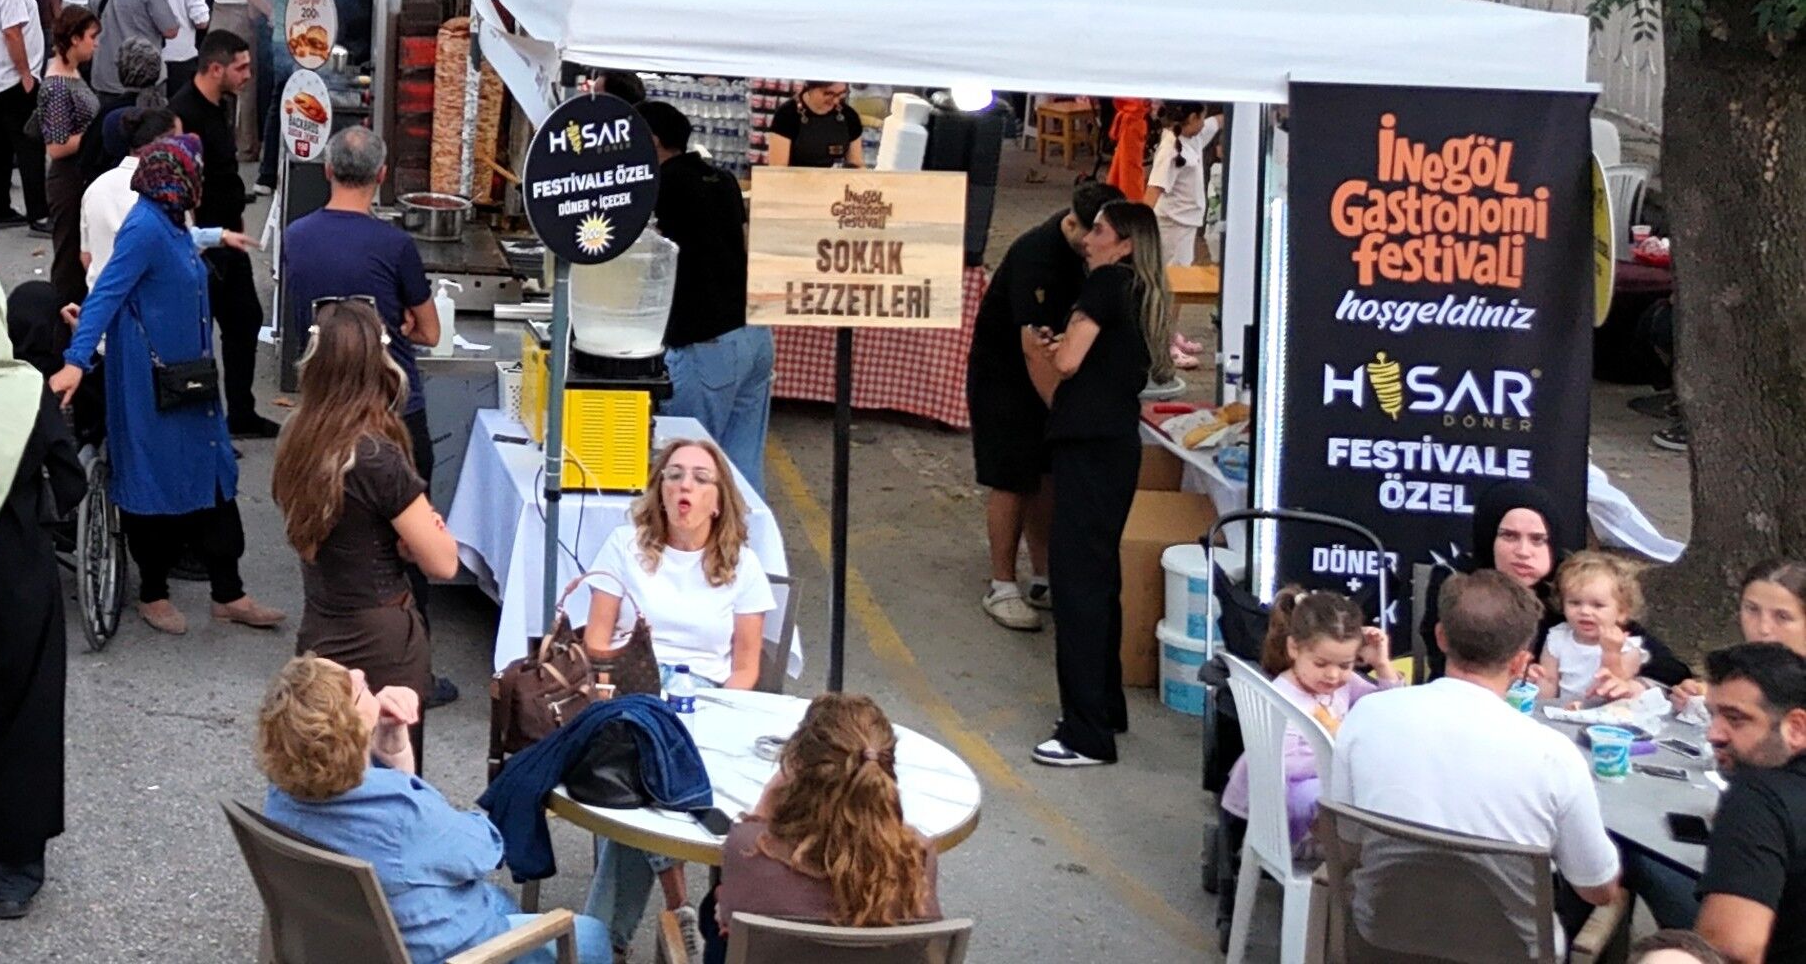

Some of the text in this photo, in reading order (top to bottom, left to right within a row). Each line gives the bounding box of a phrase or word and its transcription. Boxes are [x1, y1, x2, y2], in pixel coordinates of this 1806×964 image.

[532, 164, 654, 199] FESTİVALE ÖZEL
[558, 198, 590, 216] DÖNER
[599, 191, 632, 211] İÇECEK
[830, 201, 893, 217] Gastronomi
[1330, 179, 1551, 240] Gastronomi
[816, 239, 904, 275] SOKAK
[785, 279, 932, 319] LEZZETLERİ
[1335, 289, 1537, 332] hoşgeldiniz
[1443, 414, 1532, 432] DÖNER
[1327, 435, 1531, 479] FESTİVALE
[1378, 472, 1475, 513] ÖZEL
